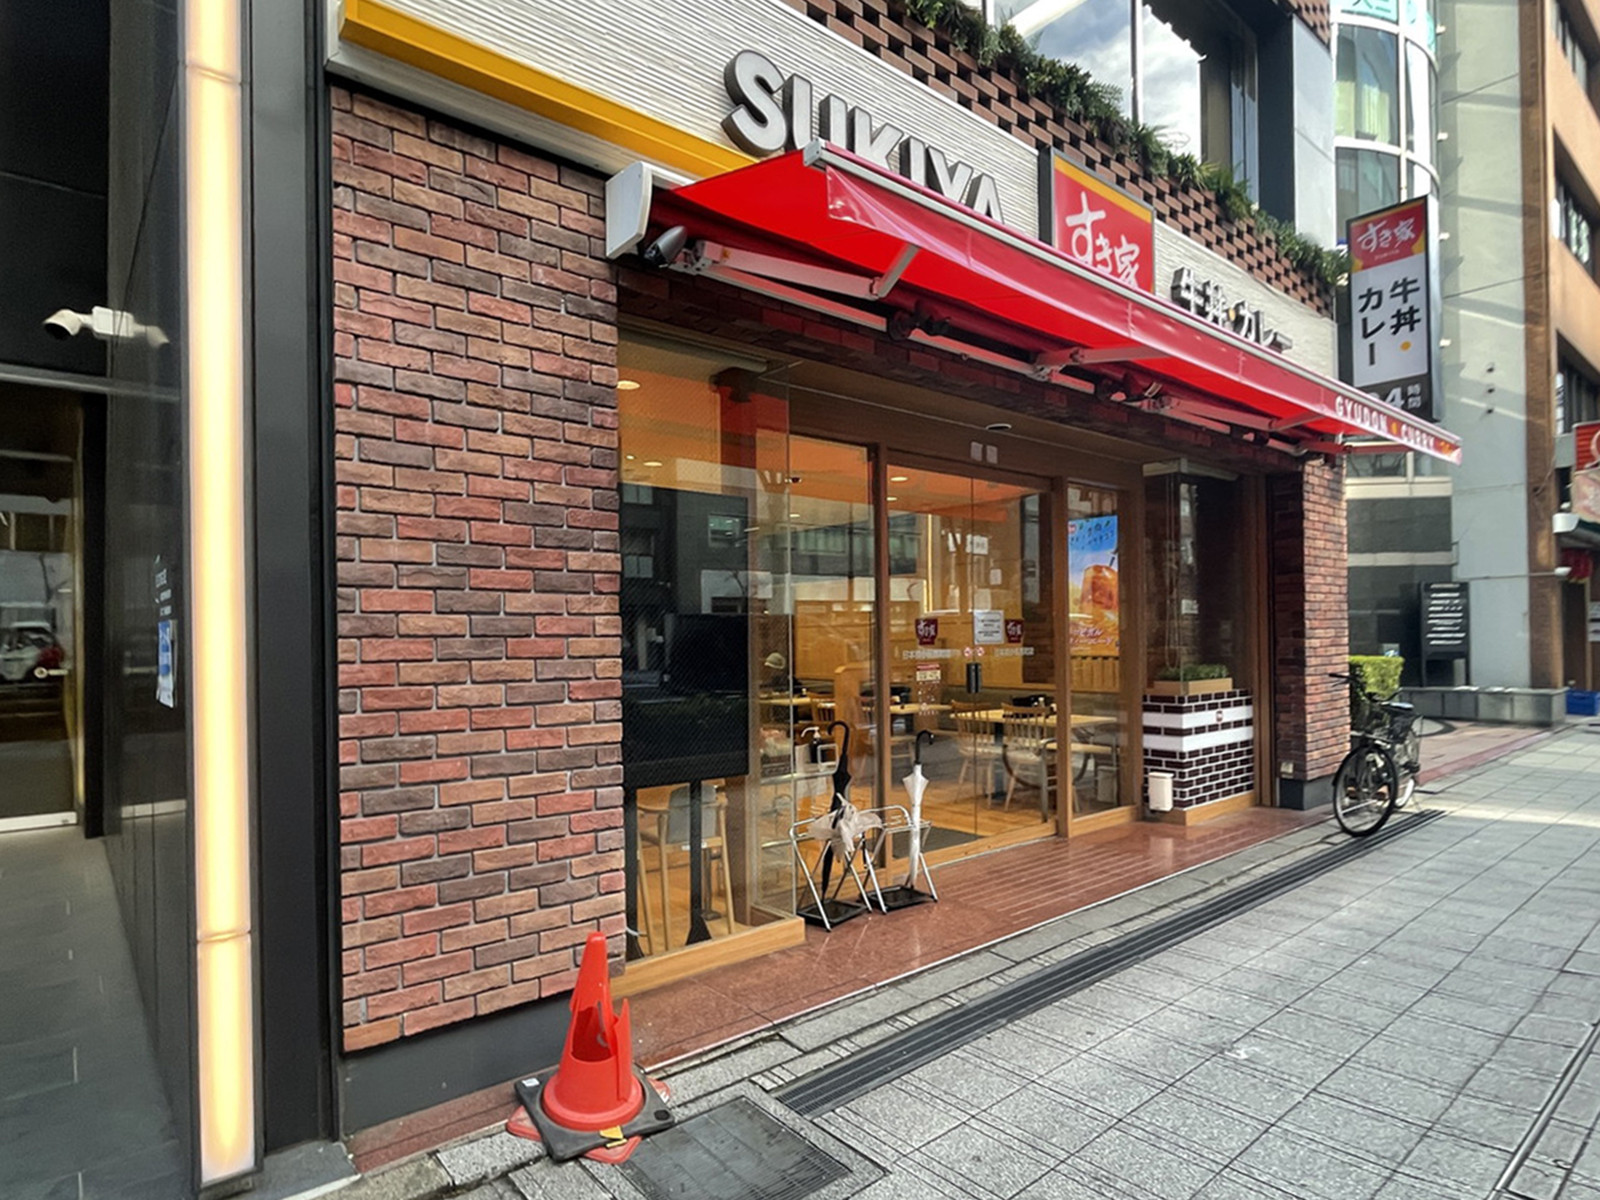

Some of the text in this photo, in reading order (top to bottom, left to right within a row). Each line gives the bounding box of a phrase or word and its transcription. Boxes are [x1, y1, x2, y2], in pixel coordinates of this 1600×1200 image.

[1065, 191, 1140, 290] すき家
[1357, 217, 1416, 252] すき家
[1358, 287, 1386, 366] カレー
[1335, 396, 1435, 449] GYUDON CURRY
